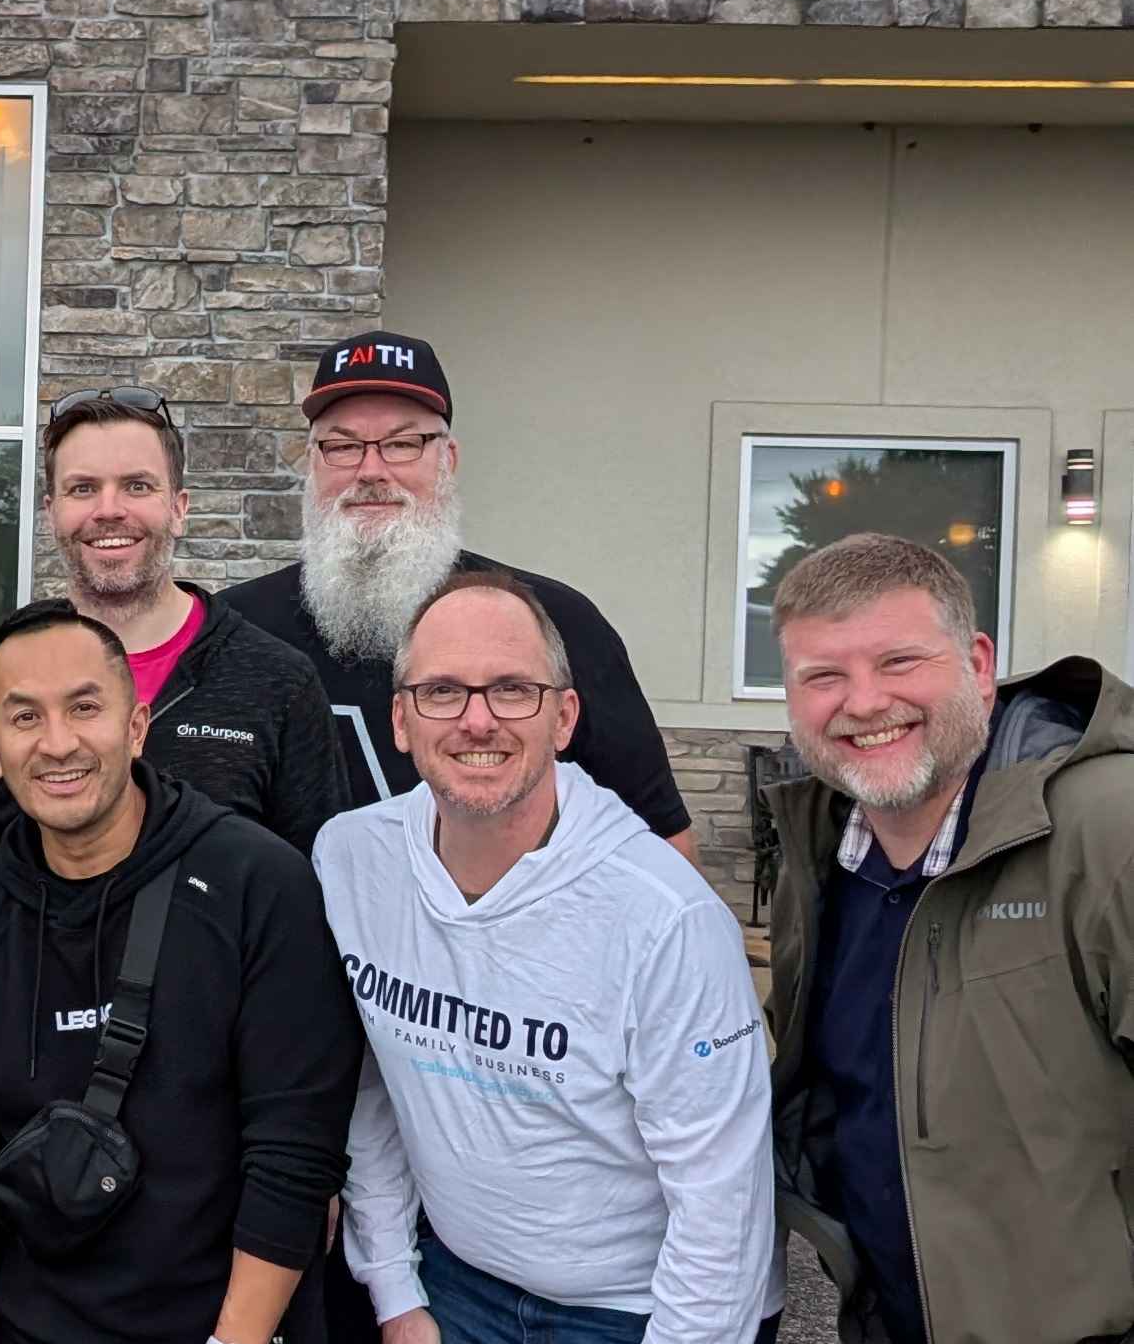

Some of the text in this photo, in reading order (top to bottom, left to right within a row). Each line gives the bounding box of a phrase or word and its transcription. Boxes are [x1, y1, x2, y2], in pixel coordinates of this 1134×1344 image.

[334, 344, 414, 372] FAITH
[201, 725, 254, 742] Purpose
[992, 901, 1047, 920] KUIU
[342, 953, 569, 1061] COMMITTED TO
[394, 1028, 457, 1055] FAMILY
[475, 1054, 565, 1084] BUSINESS
